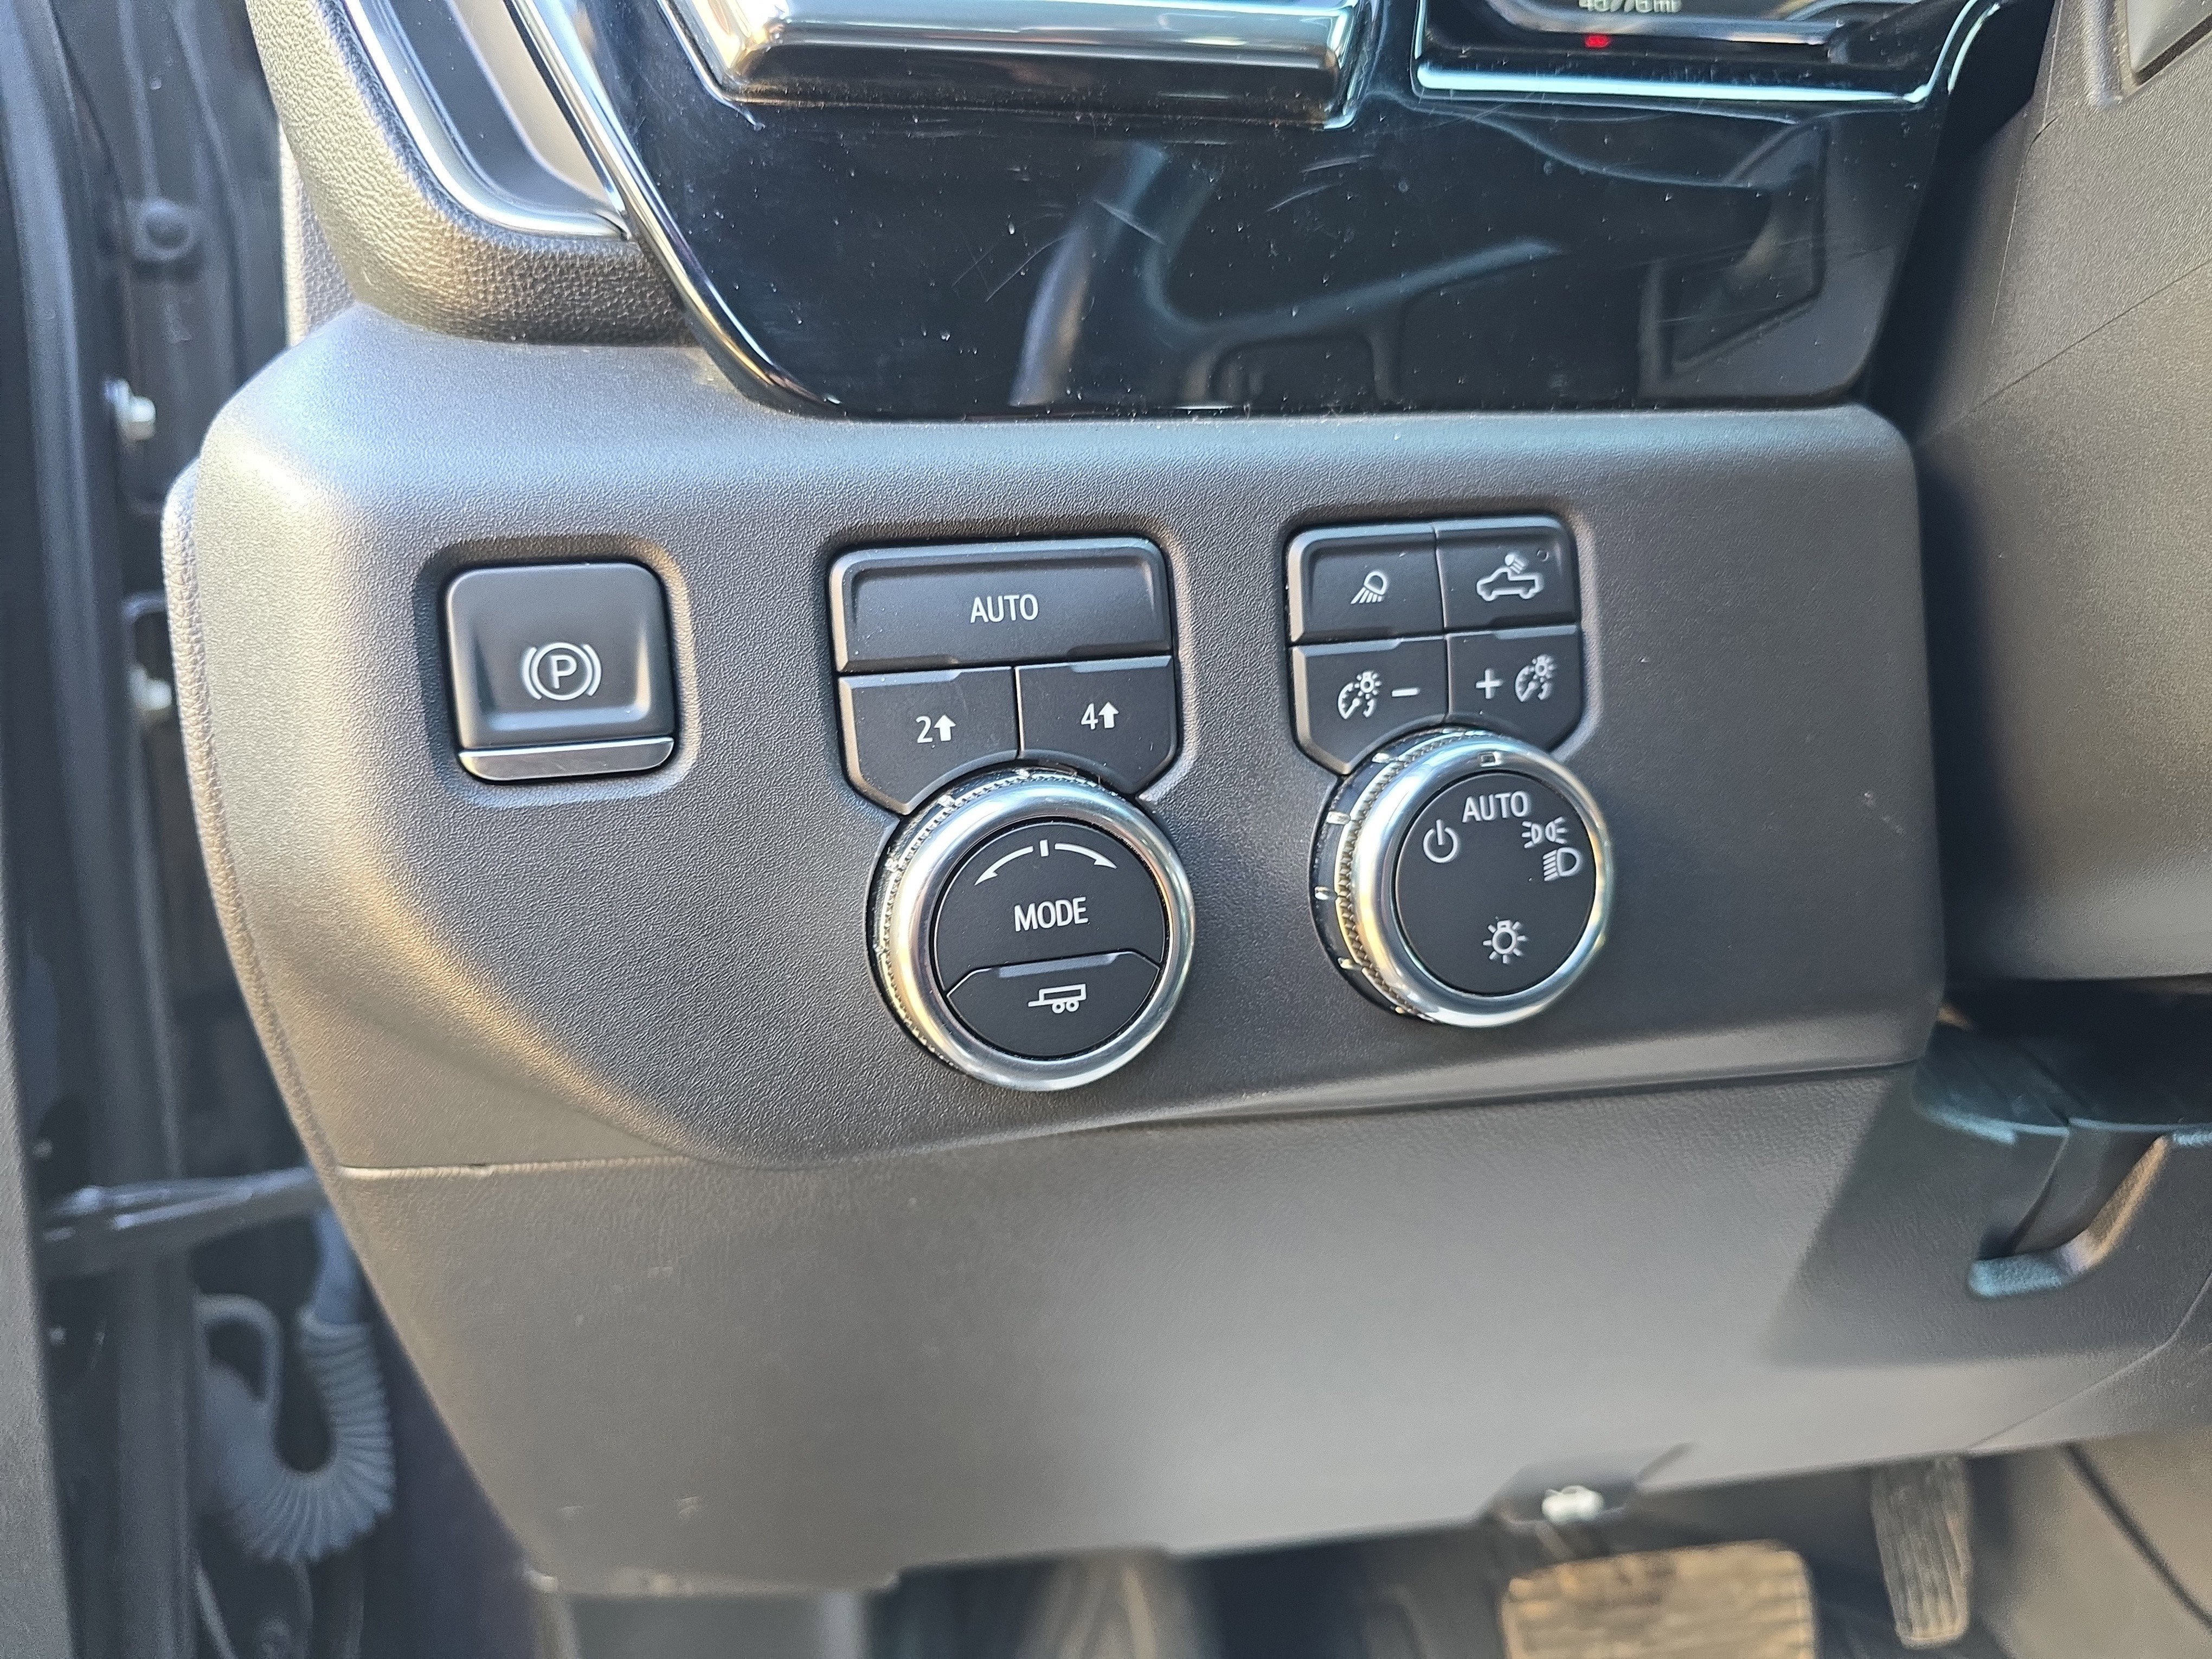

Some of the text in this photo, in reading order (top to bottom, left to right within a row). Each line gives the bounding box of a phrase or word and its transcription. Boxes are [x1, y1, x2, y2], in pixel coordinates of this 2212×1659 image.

[970, 594, 1039, 623] AUTO
[916, 716, 934, 743] 2
[1081, 703, 1099, 730] 4
[1462, 790, 1530, 823] AUTO
[1014, 896, 1089, 932] MODE
